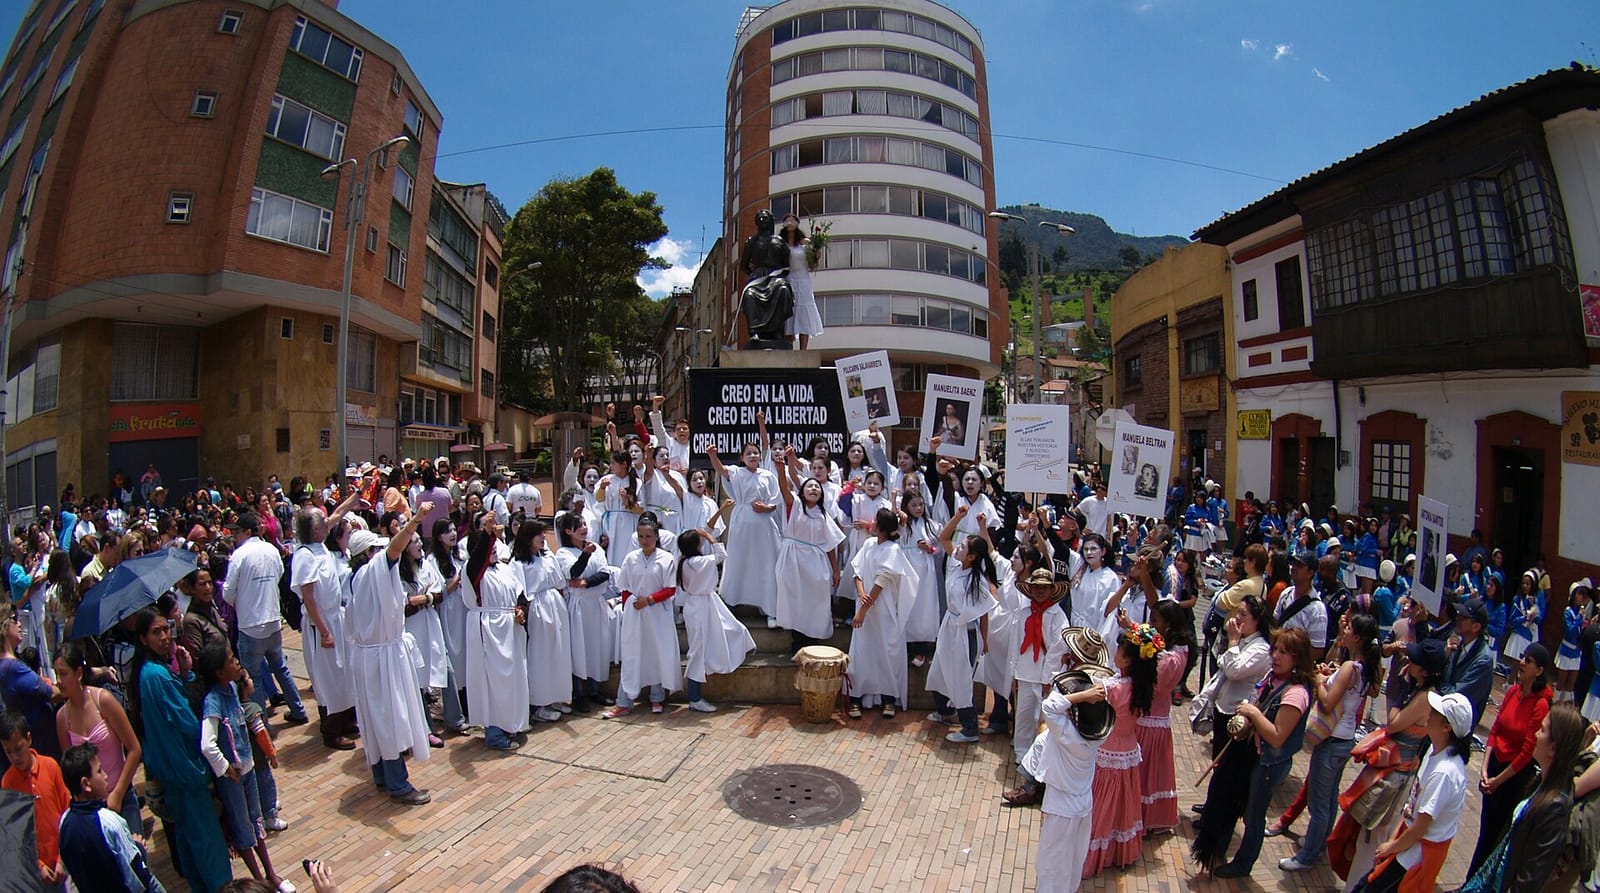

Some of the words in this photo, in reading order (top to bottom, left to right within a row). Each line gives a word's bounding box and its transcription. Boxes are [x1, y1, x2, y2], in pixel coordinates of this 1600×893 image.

[721, 384, 751, 403] CREO
[754, 384, 769, 403] EN
[772, 384, 786, 403] LA
[788, 384, 814, 403] VIDA
[933, 384, 960, 394] MANUELITA
[961, 387, 976, 396] SAENZ
[708, 406, 738, 425] CREO
[740, 406, 755, 425] EN
[757, 406, 772, 425] A
[775, 406, 827, 425] LIBERTAD
[1562, 400, 1587, 425] NUEVO
[693, 433, 716, 454] CREO
[717, 433, 729, 453] EN
[730, 433, 742, 453] LA
[805, 432, 844, 453] MRES
[1122, 433, 1145, 444] MANUELA
[1145, 437, 1167, 448] BELTRAN
